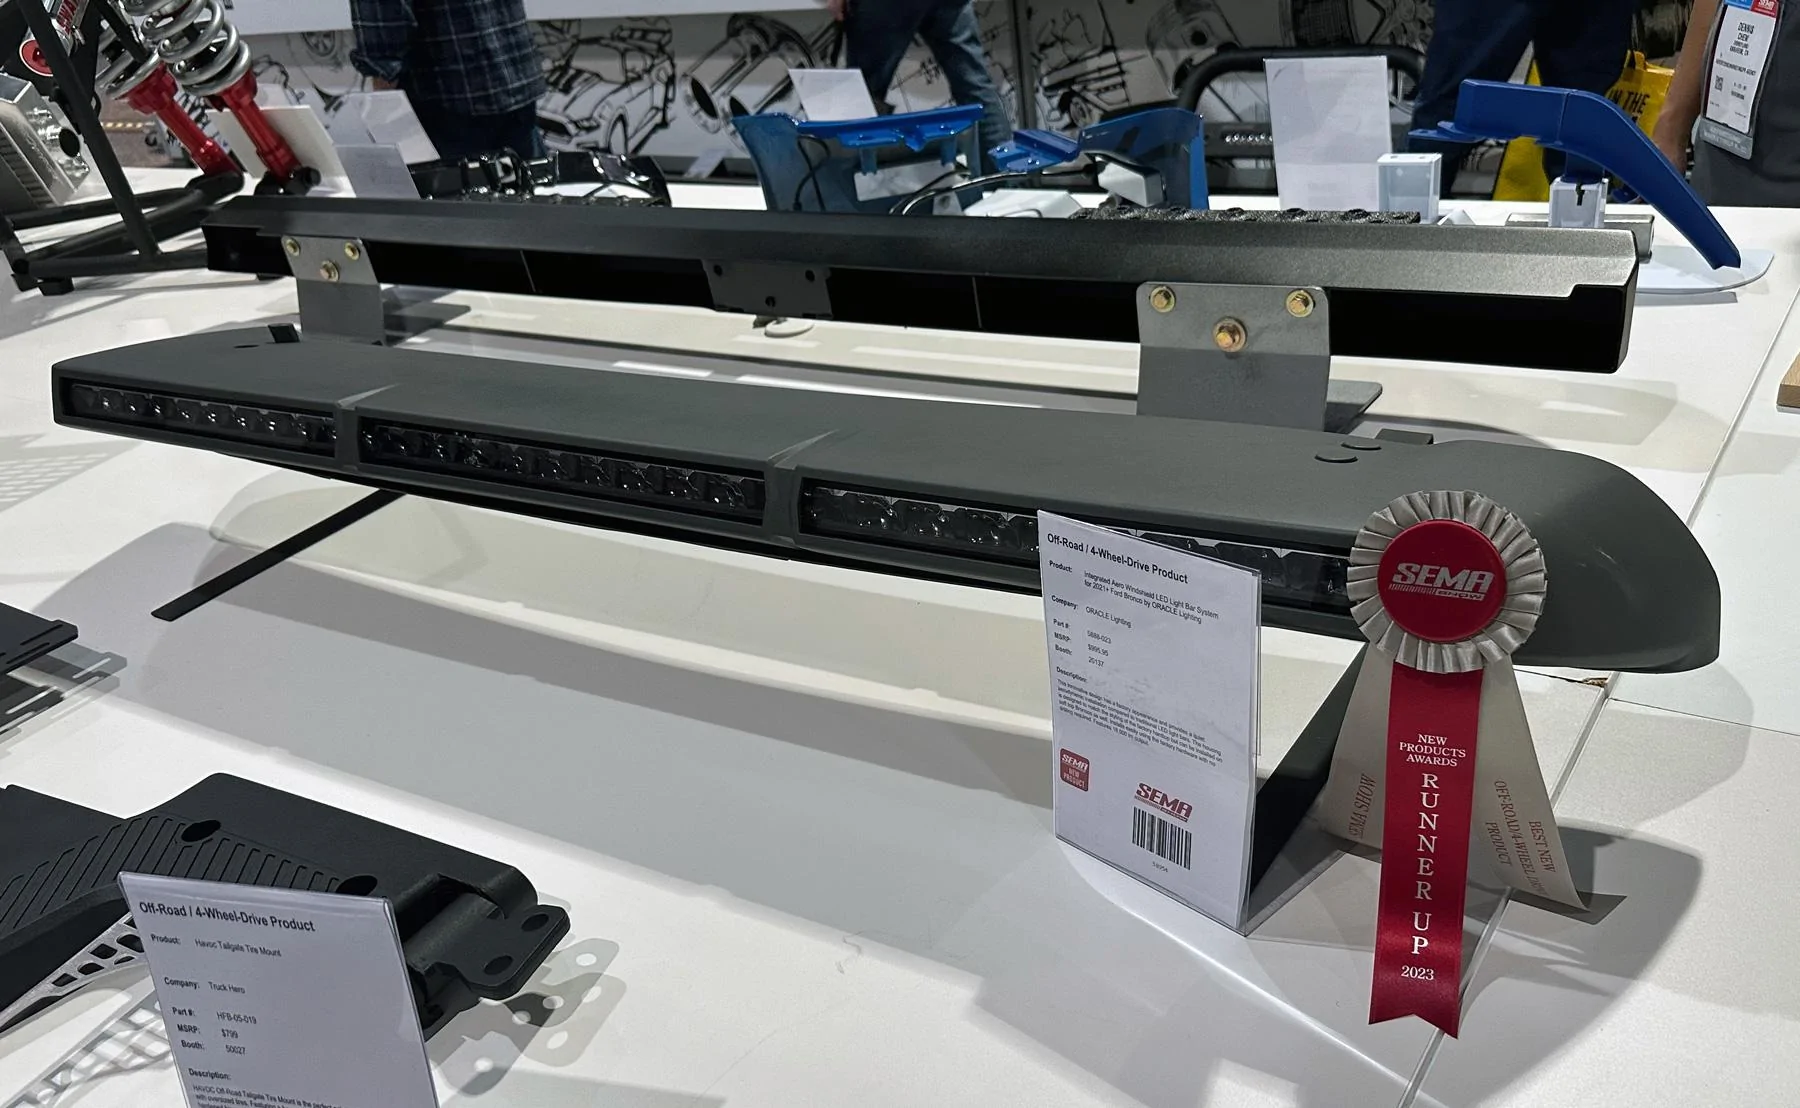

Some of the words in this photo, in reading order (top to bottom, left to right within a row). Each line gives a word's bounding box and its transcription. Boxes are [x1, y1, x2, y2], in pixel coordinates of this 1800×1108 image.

[1622, 91, 1650, 114] THE
[1047, 533, 1084, 552] Off-Road
[1085, 544, 1089, 554] /
[1090, 545, 1150, 572] 4-Wheel-Drive
[1152, 564, 1188, 584] Product
[1049, 559, 1073, 573] Product:
[1392, 562, 1495, 593] SEMA
[1051, 594, 1078, 611] Company:
[1084, 570, 1110, 585] Integrated
[1111, 580, 1124, 590] Aero
[1125, 584, 1155, 600] Windshield
[1155, 593, 1168, 604] LED
[1169, 597, 1184, 609] Light
[1184, 602, 1196, 612] Bar
[1196, 606, 1219, 620] System
[1093, 582, 1109, 592] 2021+
[1110, 588, 1123, 598] Ford
[1124, 592, 1143, 605] Bronco
[1143, 598, 1151, 609] by
[1151, 602, 1178, 616] ORACLE
[1178, 611, 1202, 625] Lighting
[1086, 606, 1110, 620] ORACLE
[1110, 613, 1132, 629] Lighting
[1417, 733, 1448, 746] NEW
[1399, 742, 1466, 758] PRODUCTS
[1062, 754, 1088, 771] SEMA
[1406, 754, 1458, 767] AWARDS
[1136, 782, 1193, 819] SEMA
[1354, 773, 1377, 813] SHOW
[1414, 773, 1439, 901] RUNNER
[1528, 821, 1547, 847] BEST
[1485, 822, 1512, 867] PRODUCT
[1537, 846, 1556, 873] NEW
[140, 901, 187, 917] Off-Road
[188, 905, 193, 917] /
[195, 906, 268, 926] 4-Wheel-Drive
[270, 916, 316, 932] Product
[150, 933, 181, 945] Product:
[1411, 911, 1432, 955] UP
[194, 939, 217, 949] Havoc
[217, 940, 244, 952] Tailgate
[245, 944, 259, 955] Tire
[259, 947, 282, 957] Mount
[1401, 965, 1435, 981] 2023
[164, 976, 200, 990] Company:
[208, 981, 228, 992] Truck
[228, 984, 246, 994] Hero
[172, 1006, 187, 1016] Part
[216, 1011, 257, 1025] HFB-05-019
[177, 1023, 201, 1034] MSRP:
[221, 1028, 239, 1039] $799
[181, 1039, 206, 1050] Booth:
[188, 1067, 232, 1080] Description:
